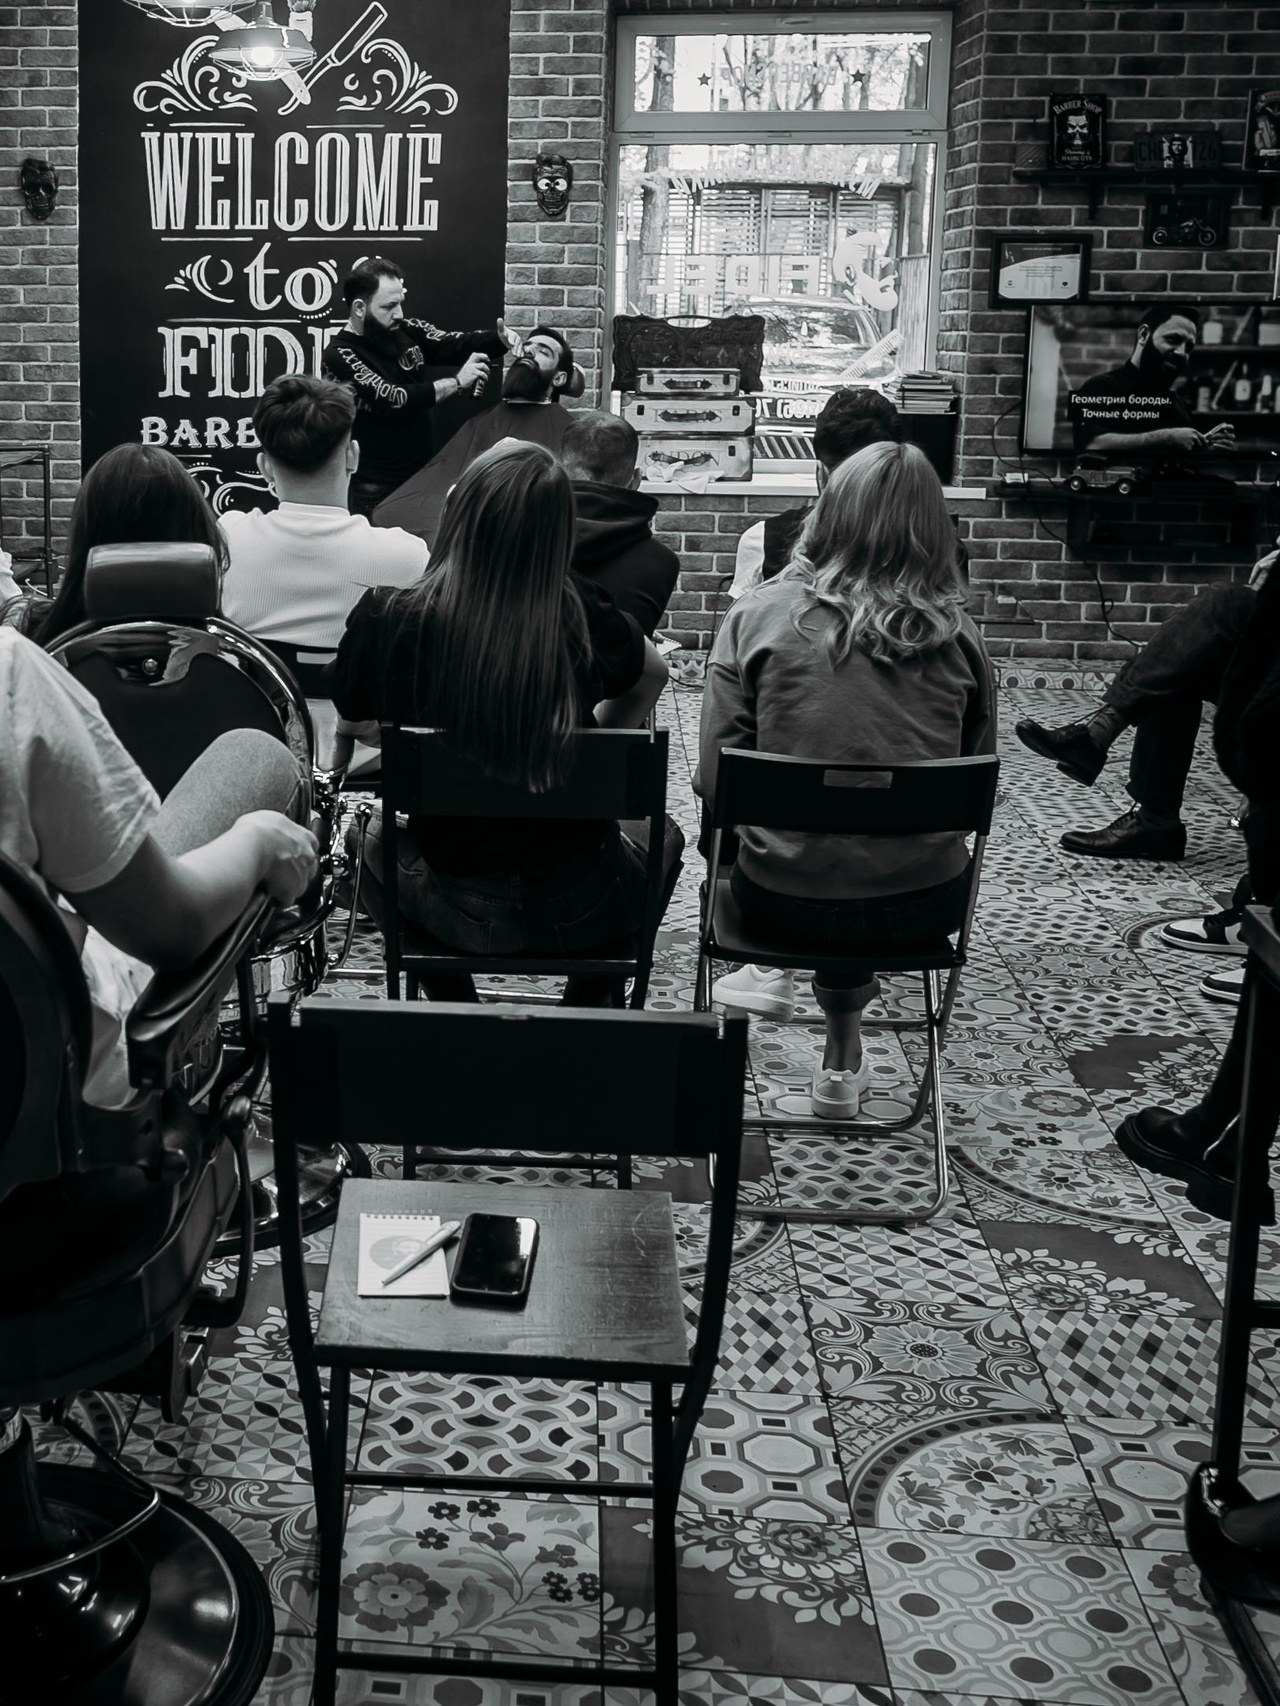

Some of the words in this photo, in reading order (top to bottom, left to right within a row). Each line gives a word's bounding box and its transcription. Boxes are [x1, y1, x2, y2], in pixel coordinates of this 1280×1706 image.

[1053, 100, 1081, 115] BARBER
[140, 131, 442, 232] WELCOME
[244, 242, 334, 312] to
[1071, 393, 1126, 406] Геометрия
[1128, 393, 1173, 406] бороды.
[1082, 408, 1120, 419] Точные
[1122, 408, 1160, 420] формы
